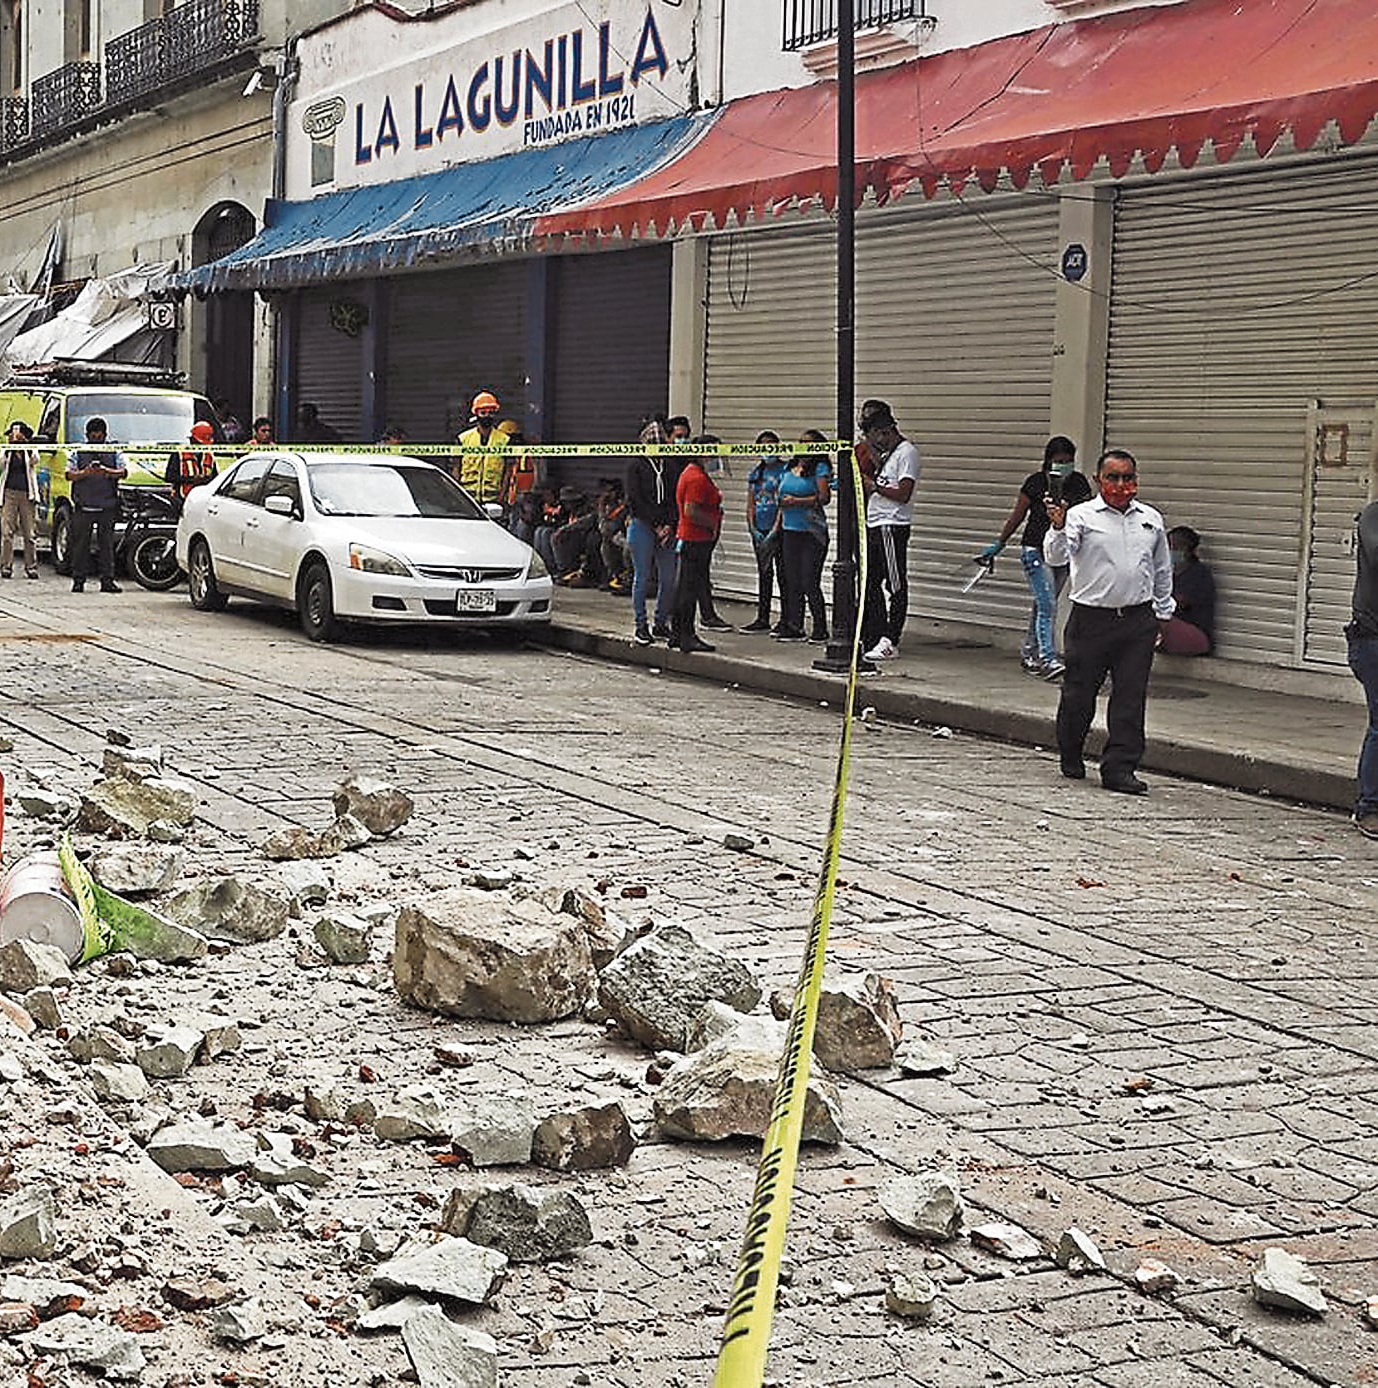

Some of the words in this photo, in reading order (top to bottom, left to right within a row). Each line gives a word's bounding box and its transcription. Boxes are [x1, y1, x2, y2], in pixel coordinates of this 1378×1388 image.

[354, 95, 400, 166] LA
[413, 5, 669, 151] LAGUNILLA
[523, 111, 582, 146] FUNDADA
[584, 106, 602, 131] EN
[605, 94, 636, 124] 1921
